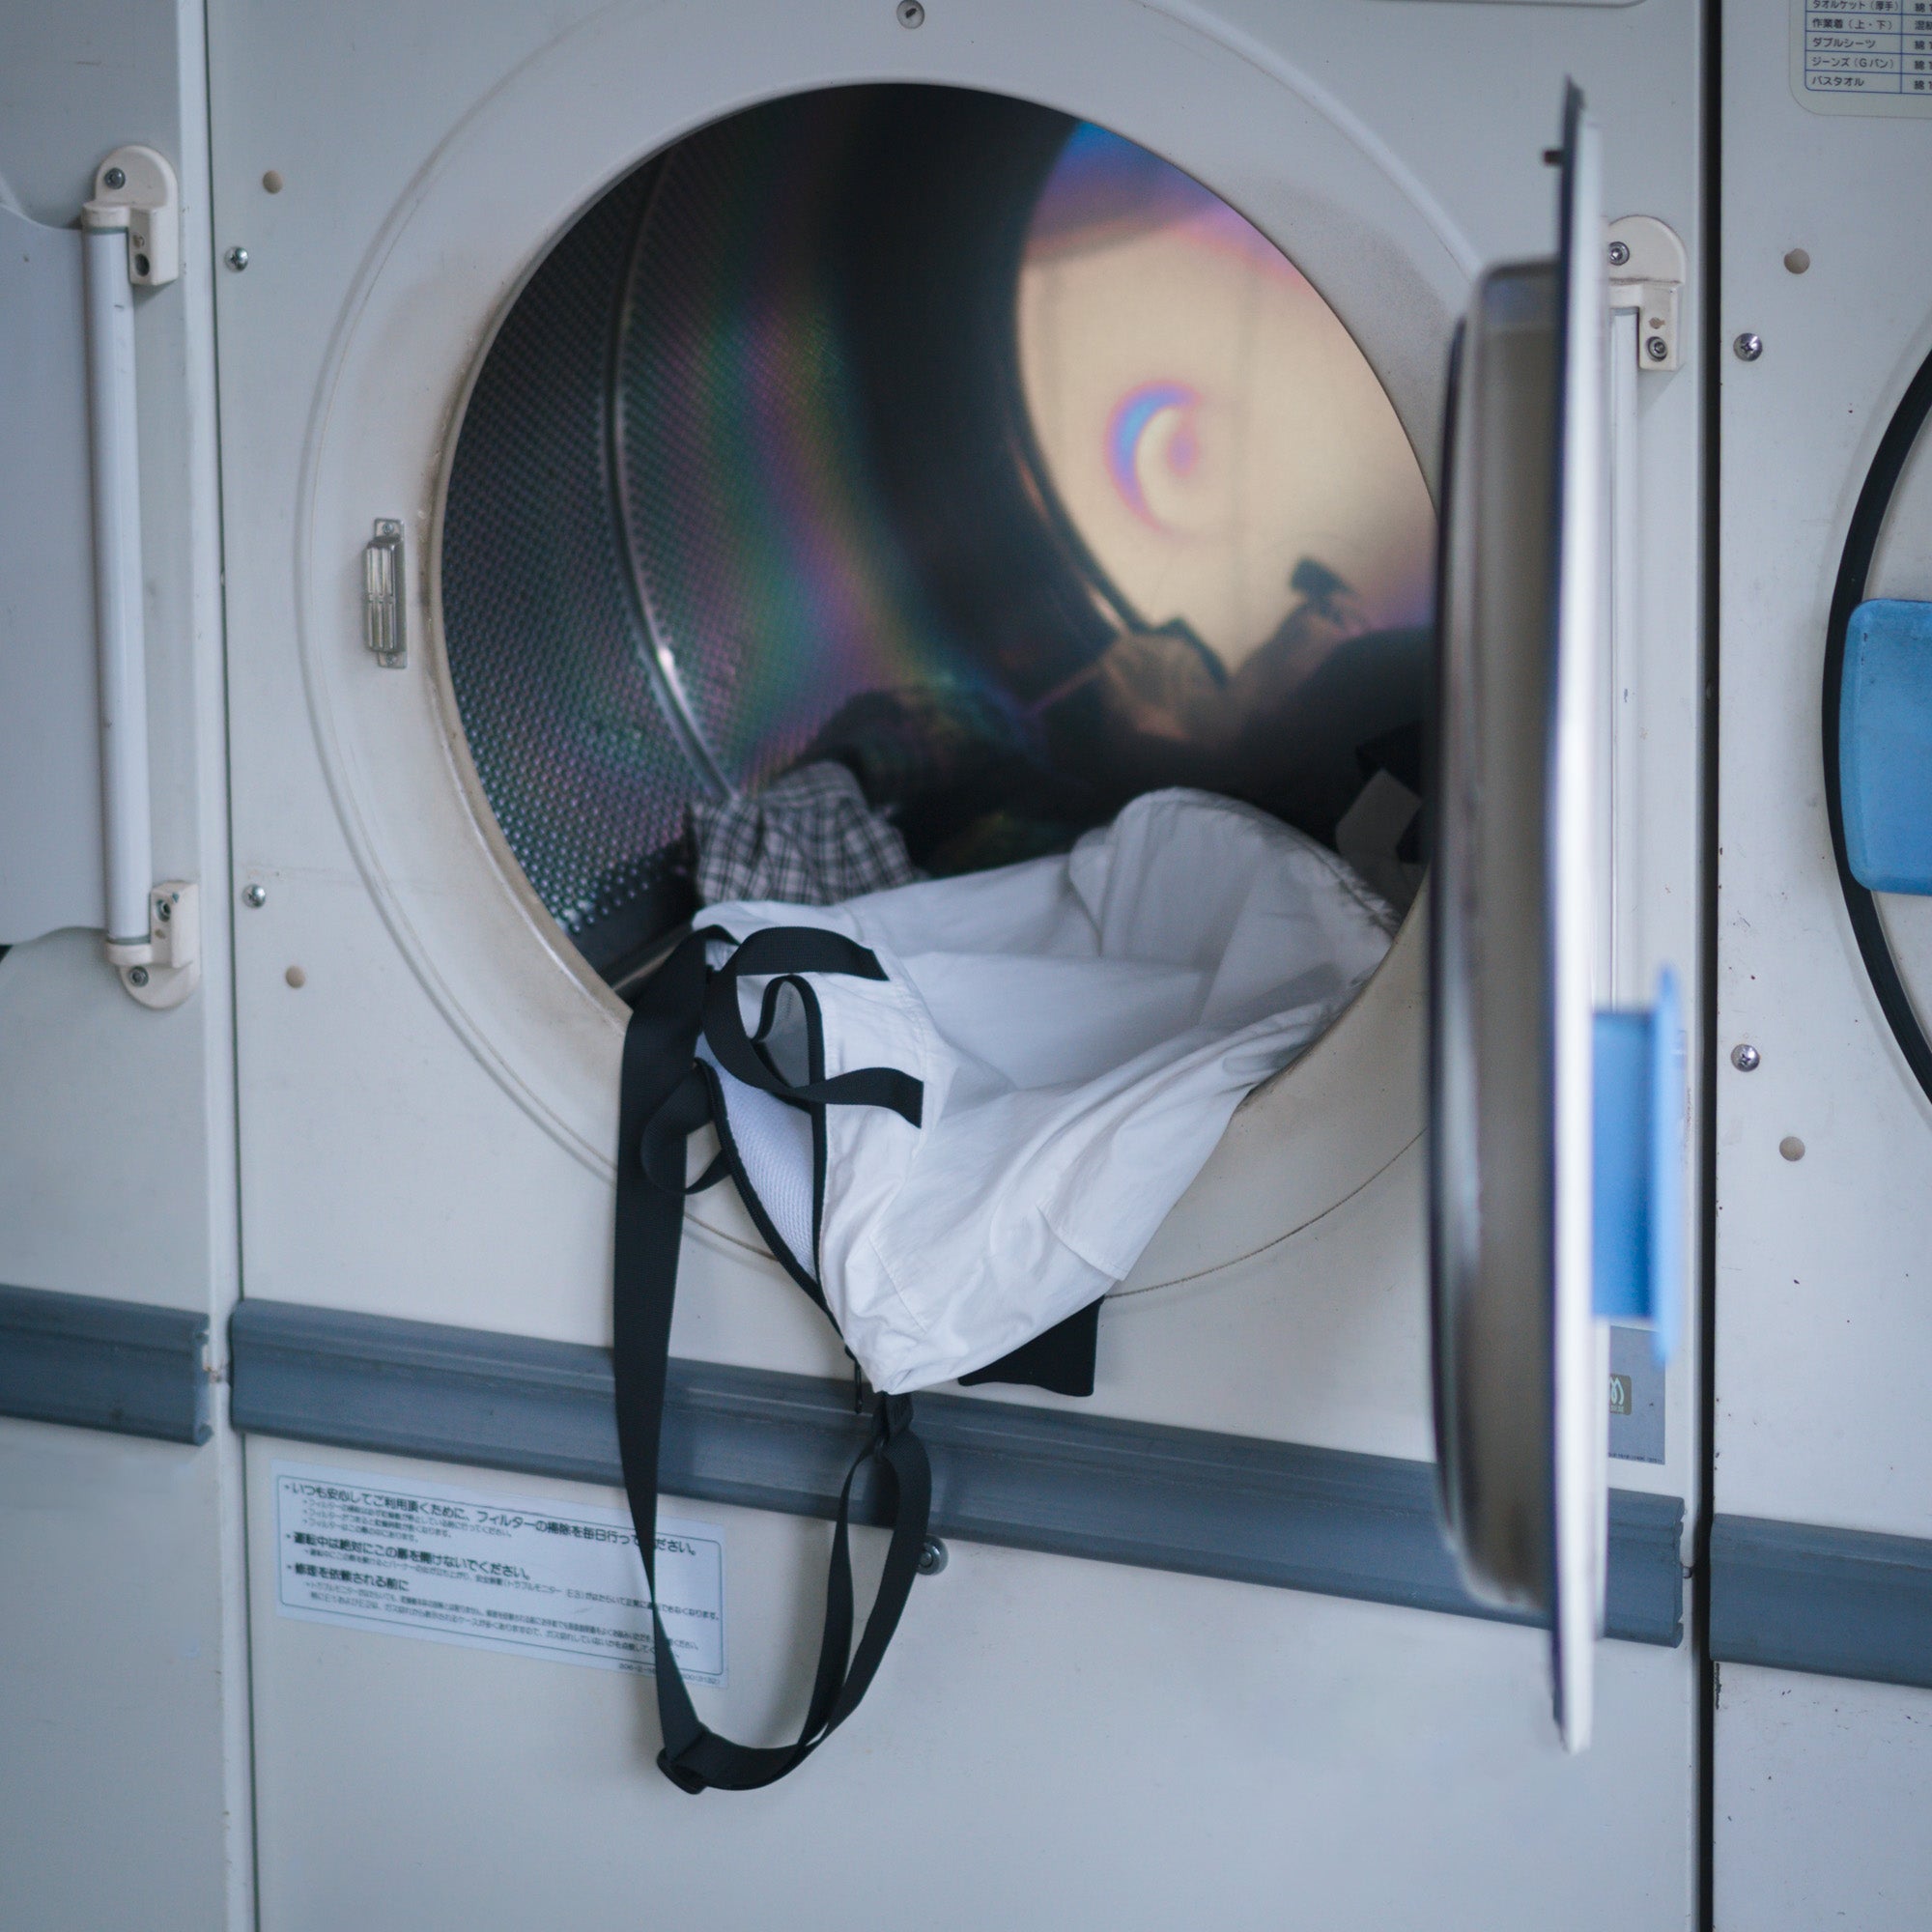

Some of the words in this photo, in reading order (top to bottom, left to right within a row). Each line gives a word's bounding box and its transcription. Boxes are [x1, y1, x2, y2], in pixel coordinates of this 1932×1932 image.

[1812, 37, 1876, 48] ダブルシーツ
[1811, 76, 1865, 87] バスタオル
[292, 1481, 696, 1555] いつも安心してご利用頂くために、フィルターの掃除を毎日行ってださい。
